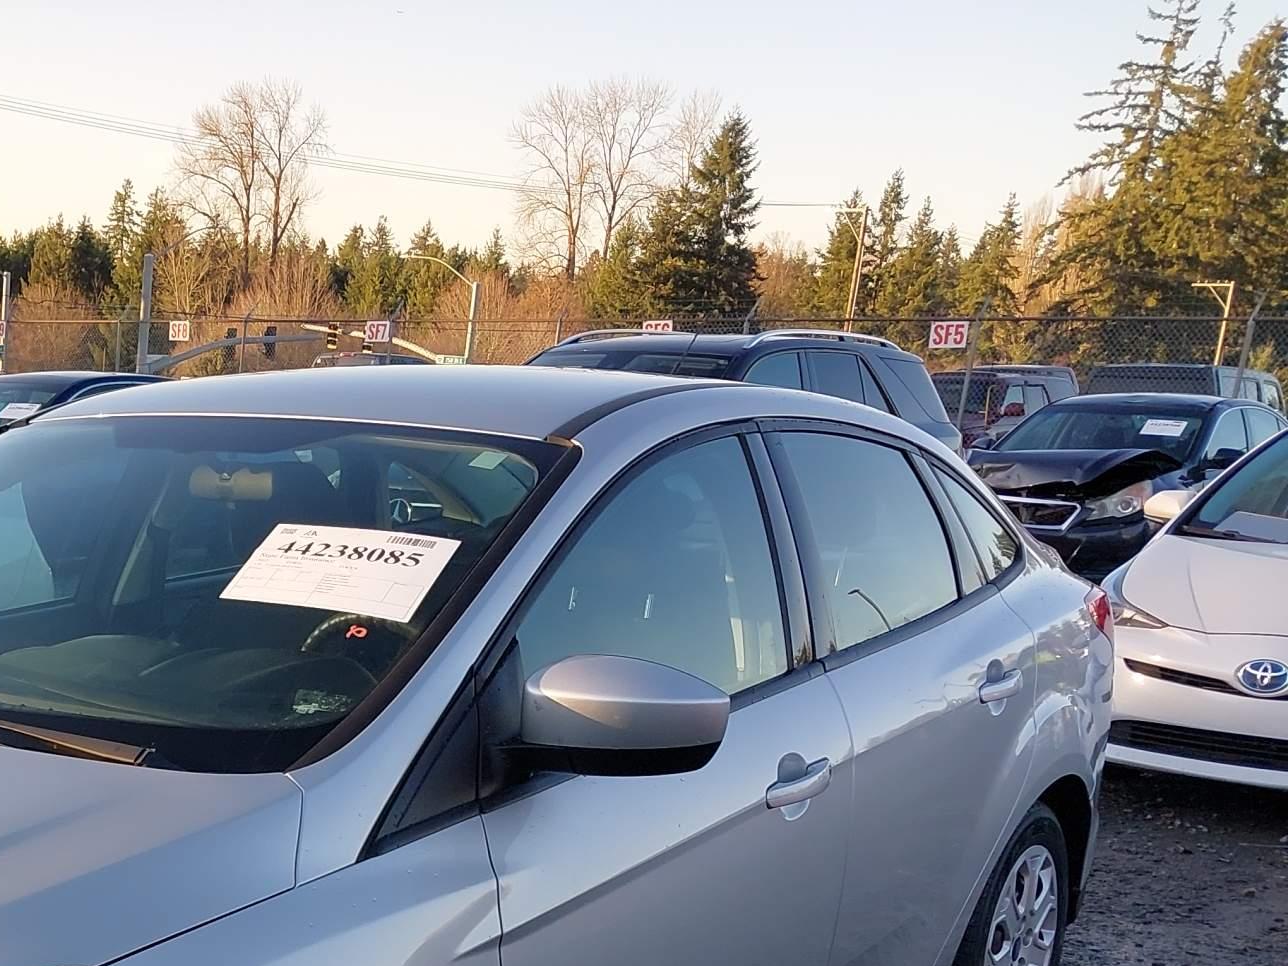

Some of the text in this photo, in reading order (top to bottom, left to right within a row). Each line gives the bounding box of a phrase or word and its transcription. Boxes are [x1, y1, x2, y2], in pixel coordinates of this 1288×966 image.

[171, 323, 188, 338] SF8
[367, 323, 388, 340] SF7
[932, 324, 965, 345] SF5
[276, 541, 424, 568] 44238085
